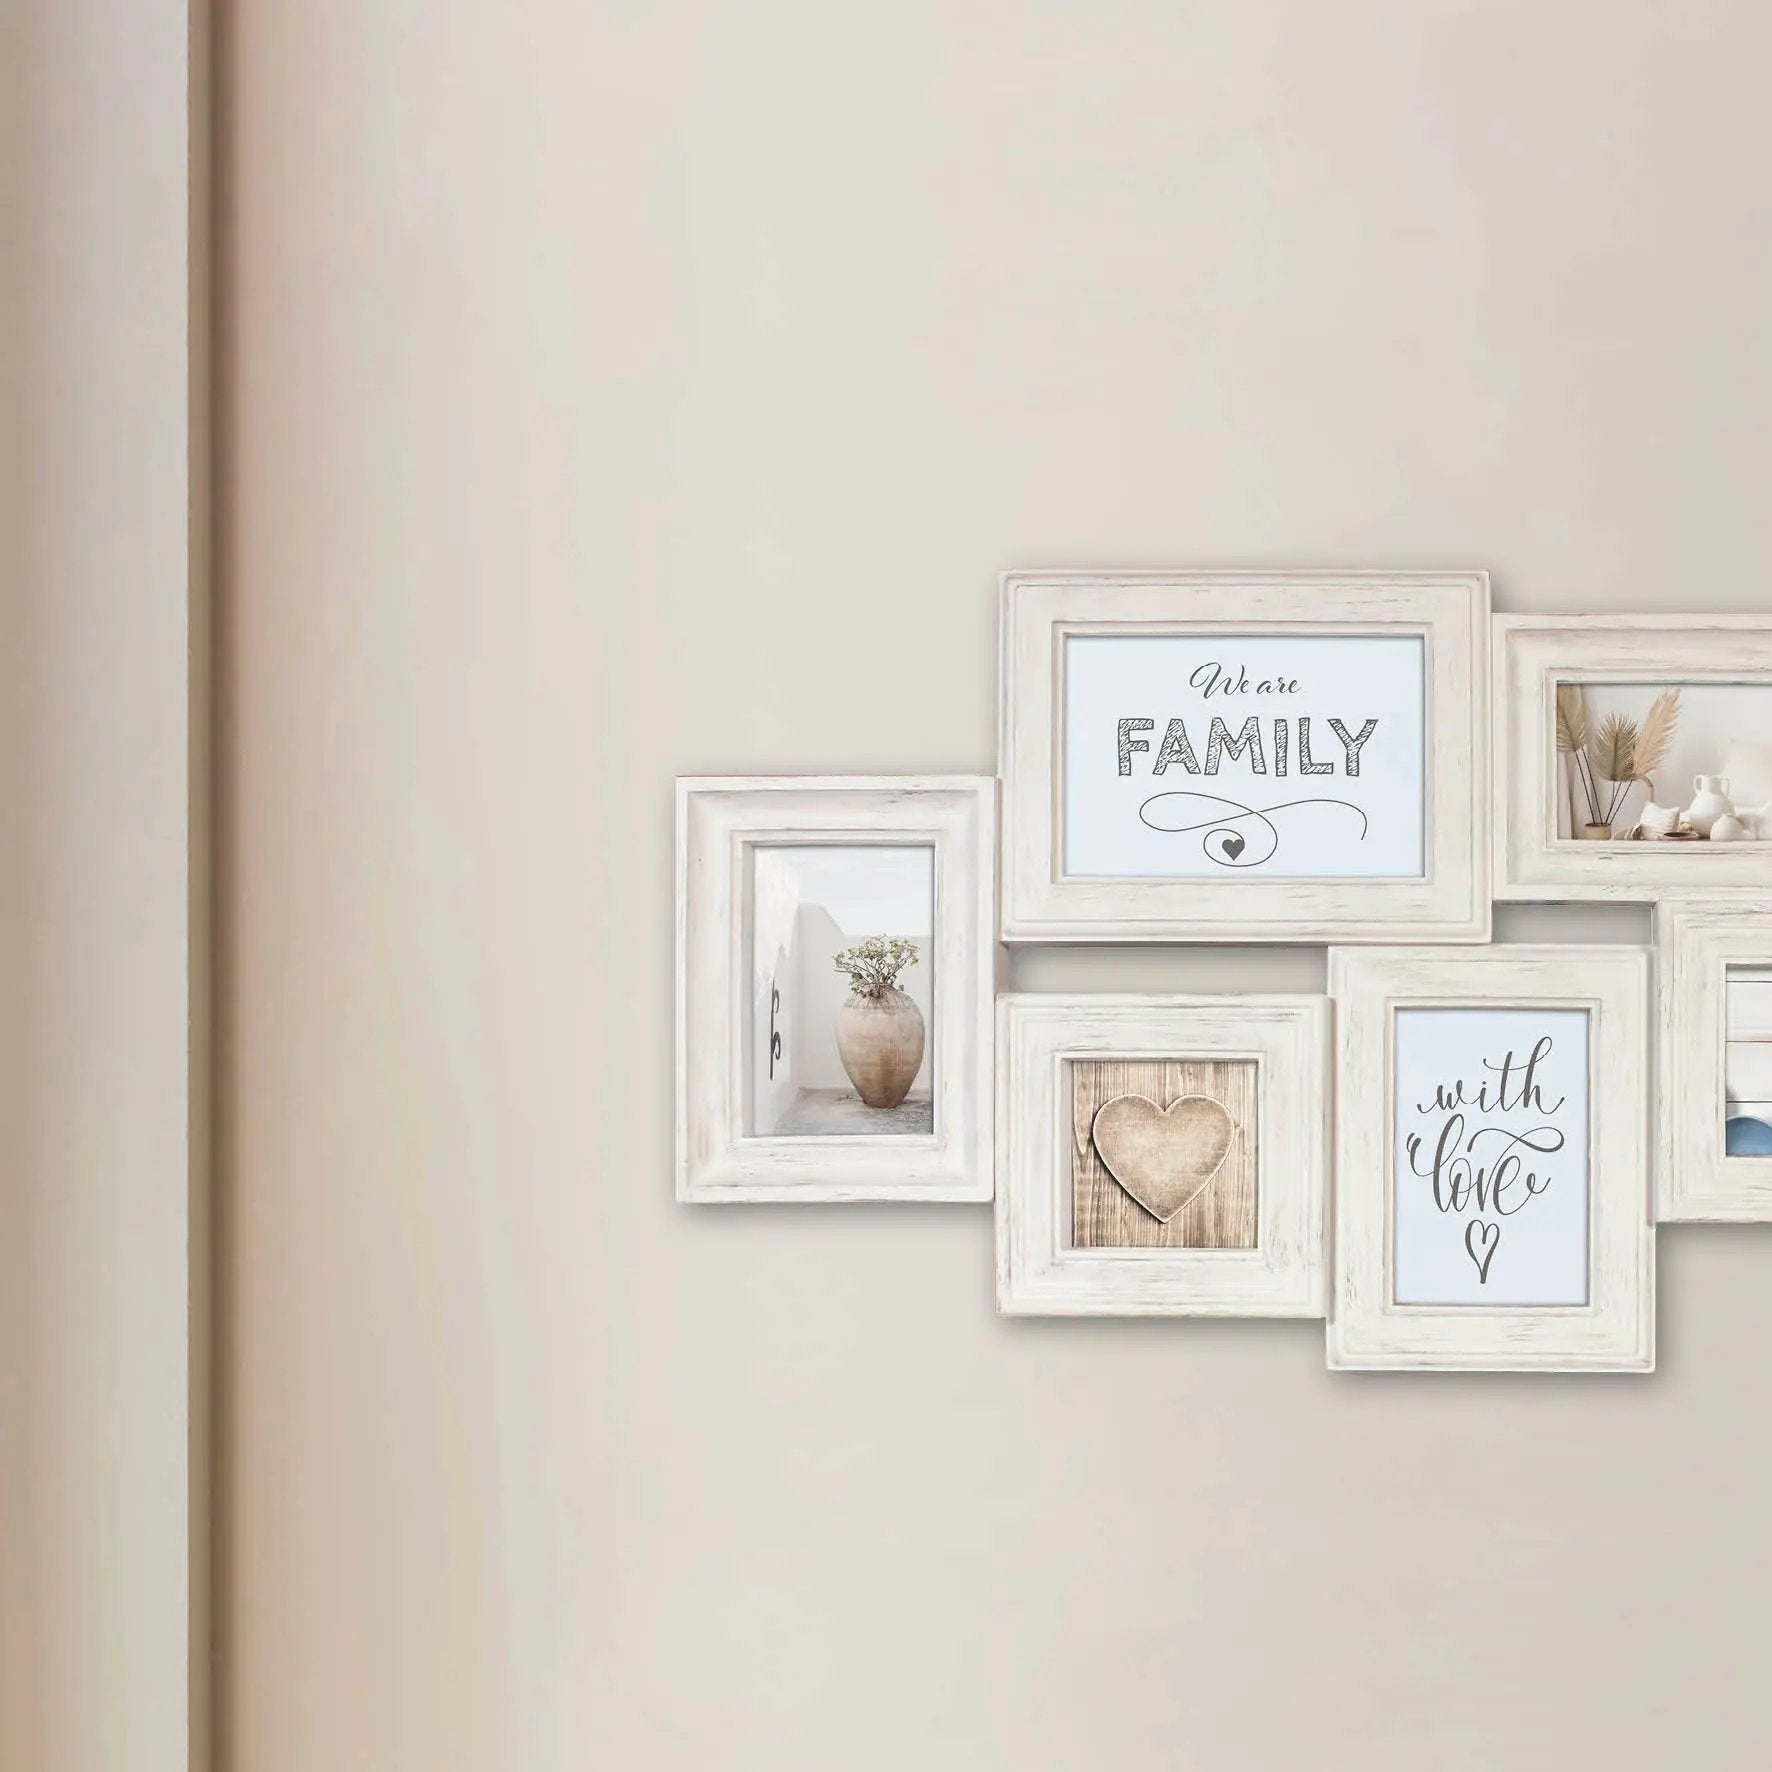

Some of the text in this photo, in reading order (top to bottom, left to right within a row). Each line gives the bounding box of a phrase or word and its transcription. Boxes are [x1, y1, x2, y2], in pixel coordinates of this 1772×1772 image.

[1189, 661, 1301, 699] We are
[1118, 717, 1378, 777] FAMILY
[1417, 1036, 1565, 1115] with
[1406, 1113, 1565, 1216] love
